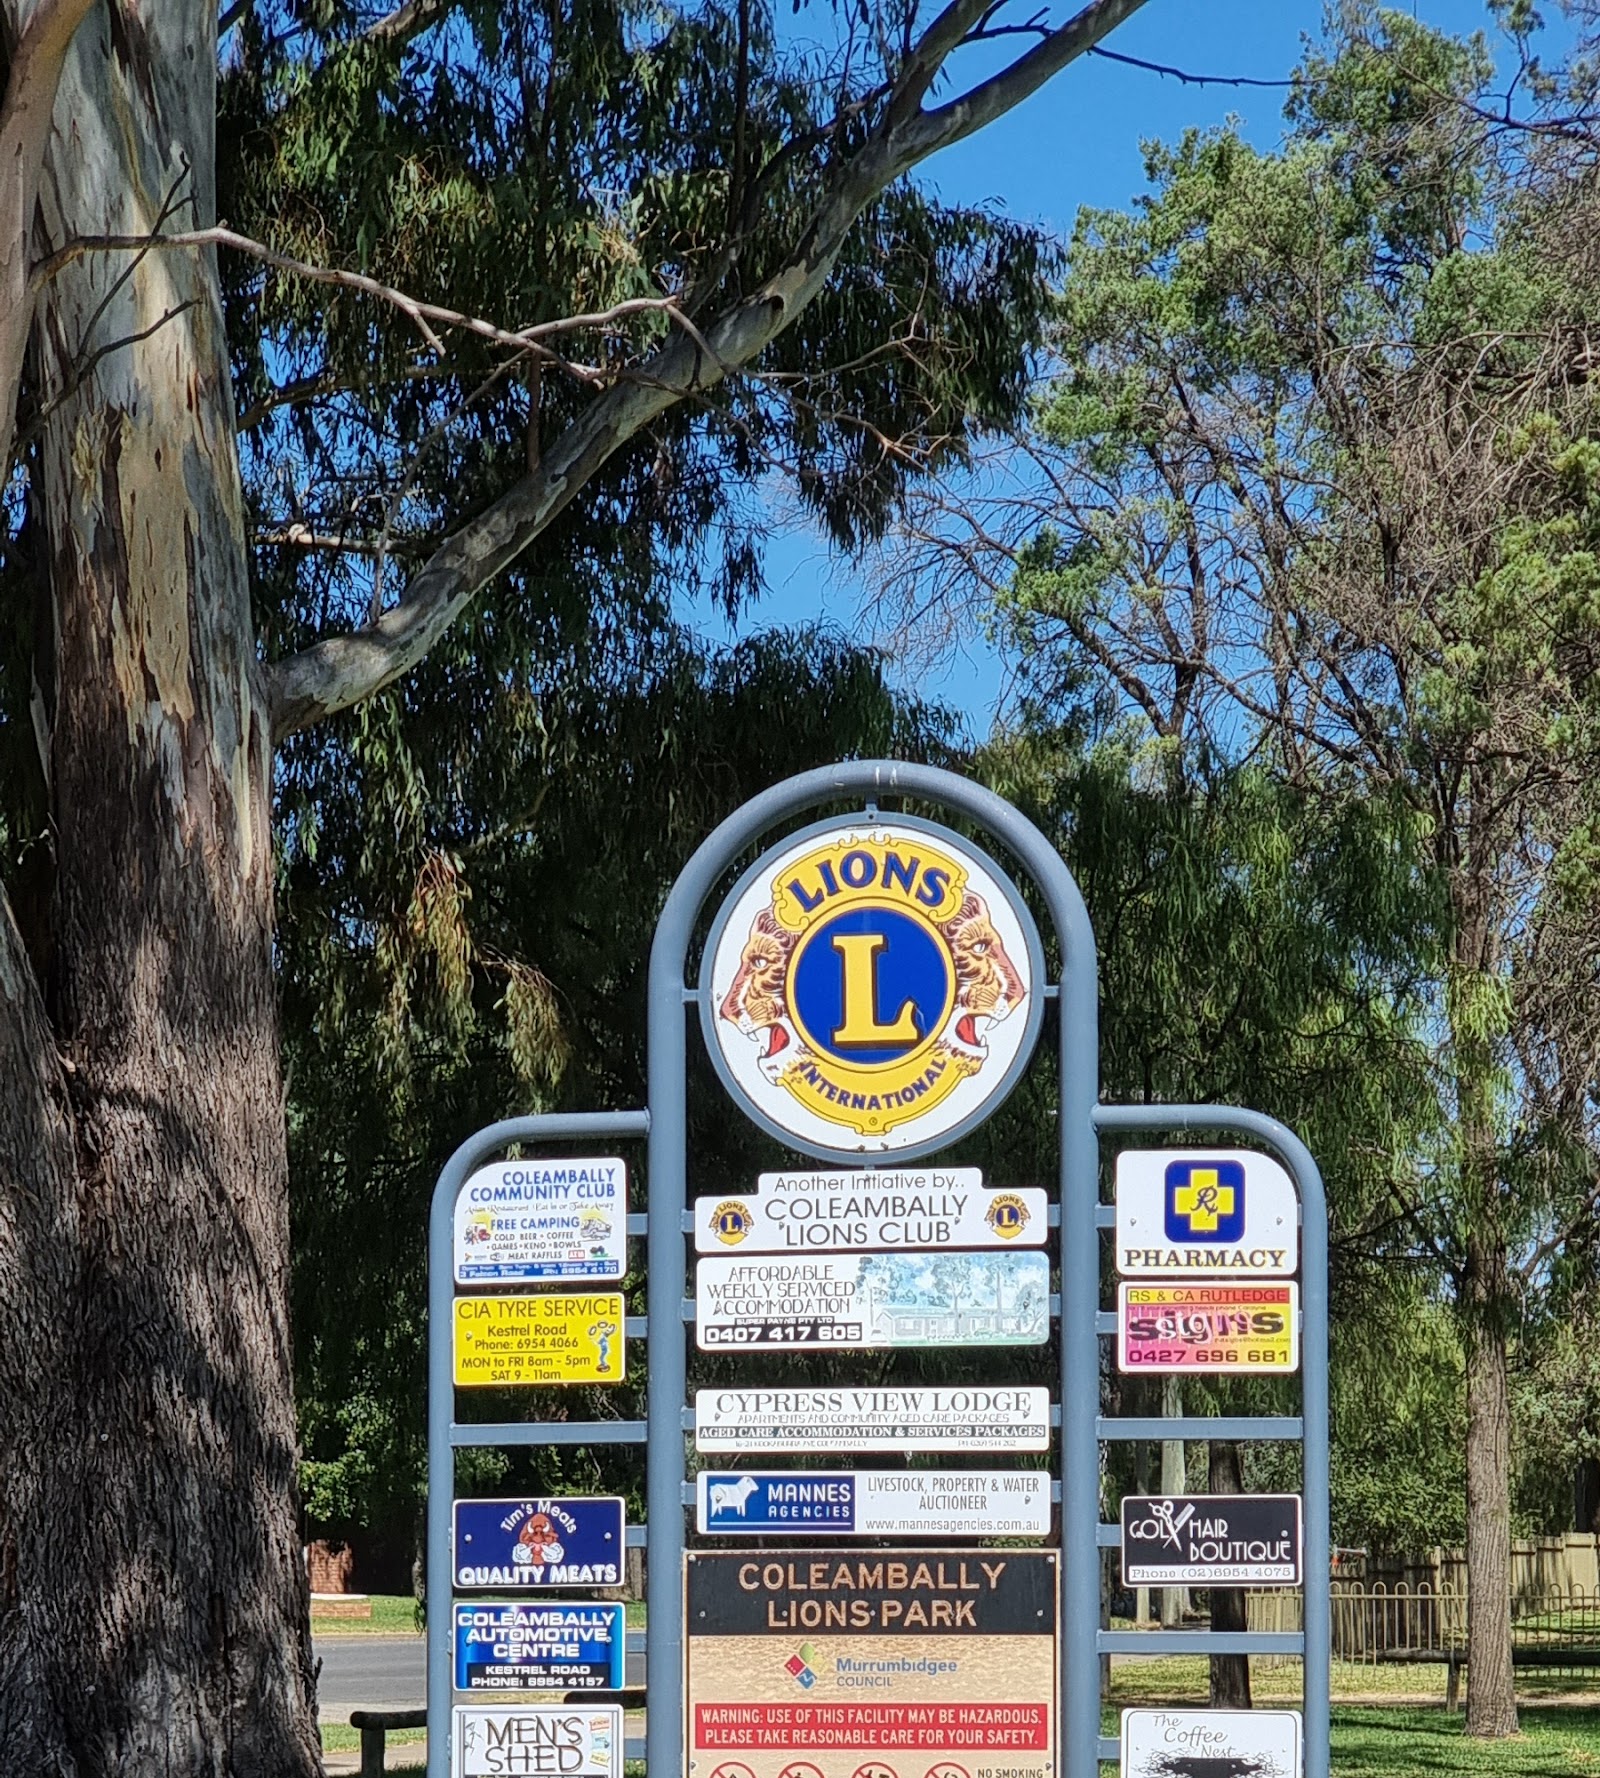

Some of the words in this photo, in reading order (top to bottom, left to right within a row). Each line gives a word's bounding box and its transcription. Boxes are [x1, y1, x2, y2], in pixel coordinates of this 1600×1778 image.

[787, 849, 952, 913] LIONS
[831, 934, 923, 1049] L
[799, 1059, 947, 1110] INTERNATIONAL
[503, 1168, 615, 1186] COLEAMBALLY
[774, 1177, 844, 1193] Another
[470, 1185, 570, 1202] COMMUNITY
[577, 1184, 615, 1198] CLUB
[995, 1196, 1019, 1204] LIONS
[719, 1203, 743, 1211] LIONS
[765, 1194, 968, 1221] COLEAMBALLY
[491, 1219, 516, 1230] FREE
[521, 1216, 580, 1229] CAMPING
[494, 1233, 515, 1241] COLD
[520, 1232, 537, 1240] BEER
[785, 1223, 867, 1246] LIONS
[879, 1223, 951, 1244] CLUB
[508, 1252, 528, 1260] MEAT
[1124, 1249, 1286, 1267] PHARMACY
[728, 1265, 834, 1282] AFFORDABLE
[707, 1282, 773, 1299] WEEKLY
[778, 1280, 856, 1298] SERVICED
[1129, 1291, 1150, 1301] RS
[1157, 1291, 1165, 1301] &
[1173, 1291, 1194, 1300] CA
[1200, 1290, 1287, 1300] RUTLEDGE
[458, 1302, 490, 1319] CIA
[498, 1301, 536, 1317] TYRE
[544, 1298, 618, 1317] SERVICE
[712, 1298, 850, 1316] ACCOMMODATION
[488, 1324, 530, 1337] Kestrel
[535, 1323, 567, 1335] Road
[706, 1328, 762, 1342] 0407
[769, 1326, 811, 1341] 417
[819, 1325, 861, 1340] 605
[475, 1339, 513, 1351] Phone:
[517, 1339, 546, 1349] 6954
[550, 1338, 579, 1348] 4066
[462, 1357, 490, 1368] MON
[494, 1357, 504, 1368] to
[508, 1357, 524, 1367] FRI
[528, 1356, 554, 1366] 8am
[565, 1356, 591, 1368] 5pm
[1129, 1350, 1186, 1362] 0427
[1196, 1350, 1238, 1362] 696
[1248, 1350, 1287, 1362] 681
[491, 1370, 512, 1381] SAT
[515, 1370, 521, 1380] 9
[534, 1369, 561, 1380] 11am
[716, 1393, 842, 1414] CYPRESS
[850, 1392, 925, 1413] VIEW
[933, 1391, 1032, 1412] LODGE
[700, 1427, 736, 1438] AGED
[739, 1427, 774, 1438] CARE
[778, 1426, 892, 1437] ACCOMMODATION
[895, 1426, 906, 1437] &
[908, 1426, 972, 1437] SERVICES
[974, 1425, 1045, 1436] PACKAGES
[768, 1483, 851, 1503] MANNES
[868, 1477, 928, 1494] LIVESTOCK,
[933, 1477, 987, 1493] PROPERTY
[991, 1478, 999, 1492] &
[1003, 1477, 1039, 1492] WATER
[919, 1495, 987, 1511] AUCTIONEER
[501, 1503, 533, 1533] Tim's
[538, 1501, 577, 1534] Meats
[768, 1506, 850, 1518] AGENCIES
[866, 1518, 1040, 1532] www.mannesagencies.com.au
[1189, 1518, 1228, 1538] HAIR
[1190, 1541, 1291, 1561] BOUTIQUE
[459, 1566, 544, 1585] QUALITY
[550, 1564, 617, 1584] MEATS
[738, 1562, 1006, 1591] COLEAMBALLY
[1132, 1569, 1175, 1578] Phone
[1255, 1568, 1291, 1577] 4075
[458, 1612, 616, 1626] COLEAMBALLY
[768, 1600, 871, 1627] LIONS
[882, 1600, 977, 1627] PARK
[467, 1628, 608, 1642] AUTOMOTIVE
[493, 1644, 580, 1658] CENTRE
[486, 1665, 547, 1675] KESTREL
[550, 1665, 591, 1675] ROAD
[836, 1657, 957, 1676] Murrumbidgee
[471, 1677, 523, 1687] PHONE:
[528, 1677, 564, 1687] 6954
[568, 1677, 604, 1686] 4157
[836, 1676, 893, 1688] COUNCIL
[702, 1709, 763, 1724] WARNING:
[767, 1709, 792, 1724] USE
[795, 1709, 813, 1724] OF
[817, 1709, 845, 1724] THIS
[848, 1709, 904, 1724] FACILITY
[908, 1709, 936, 1724] MAY
[939, 1709, 957, 1724] BE
[960, 1709, 1042, 1724] HAZARDOUS.
[1153, 1715, 1183, 1727] The
[485, 1715, 584, 1746] MEN'S
[706, 1729, 754, 1744] PLEASE
[757, 1729, 789, 1744] TAKE
[793, 1729, 878, 1744] REASONABLE
[881, 1729, 915, 1744] CARE
[919, 1729, 945, 1744] FOR
[948, 1729, 984, 1744] YOUR
[987, 1729, 1038, 1744] SAFETY.
[1164, 1726, 1228, 1747] Coffee
[485, 1745, 583, 1773] SHED
[1201, 1744, 1234, 1758] Nest
[978, 1769, 992, 1778] NO
[996, 1769, 1043, 1778] SMOKING
